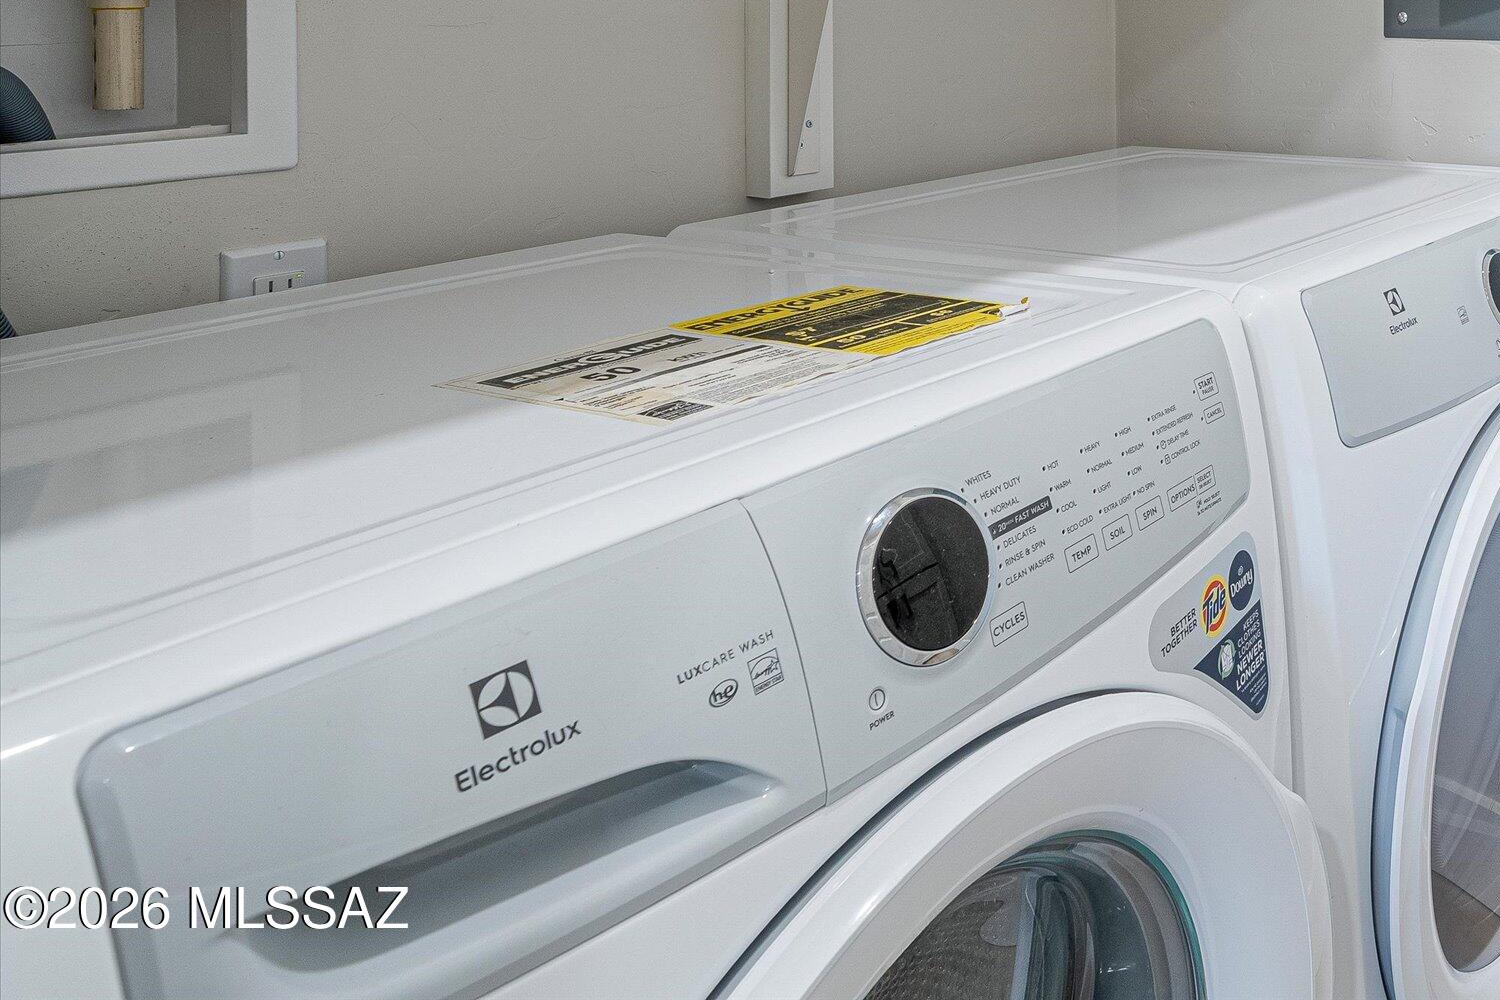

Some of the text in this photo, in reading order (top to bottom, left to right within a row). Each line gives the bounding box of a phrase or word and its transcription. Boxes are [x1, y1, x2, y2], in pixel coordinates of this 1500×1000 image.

[1389, 315, 1418, 335] Electrolux
[580, 366, 642, 382] 50
[1198, 377, 1213, 389] START
[1118, 427, 1132, 436] HIGH
[1167, 435, 1180, 446] DELAY
[1084, 441, 1100, 453] HEAVY
[1125, 442, 1144, 456] MEDIUM
[1170, 447, 1190, 460] CONTROL
[1047, 460, 1060, 470] HOT
[1091, 459, 1112, 473] NORMAL
[1131, 465, 1142, 476] LOW
[965, 470, 992, 487] WHITES
[1054, 479, 1072, 491] WARM
[1097, 481, 1112, 494] LIGHT
[1136, 480, 1156, 495] NO SPIN
[980, 476, 1022, 502] HEAVY DUTY
[1170, 484, 1196, 504] OPTIONS
[990, 496, 1020, 515] NORMAL
[1014, 510, 1030, 524] FAST
[1030, 500, 1050, 514] WASH
[1061, 500, 1078, 513] COOL
[1103, 494, 1132, 514] EXTRA LIGHT
[1142, 507, 1158, 521] SPIN
[1066, 514, 1094, 534] ECO COLD
[1110, 526, 1126, 540] SOIL
[1003, 525, 1036, 548] DELICATES
[1005, 539, 1046, 568] RINSE & SPIN
[1071, 546, 1092, 562] TEMP
[1005, 553, 1055, 586] CLEAN WASHER
[1230, 568, 1254, 598] Downy
[1202, 583, 1226, 635] Tide
[993, 612, 1026, 637] CYCLES
[1170, 608, 1197, 638] BETTER
[1243, 610, 1260, 630] KEEPS
[1161, 618, 1198, 658] TOGETHER
[1238, 619, 1260, 648] CLOTHES
[1239, 629, 1261, 658] LOOKING
[676, 629, 774, 685] LUXCARE WASH
[1237, 640, 1262, 674] NEWER
[1236, 652, 1265, 690] LONGER
[869, 710, 896, 732] POWER
[454, 720, 582, 792] Electrolux
